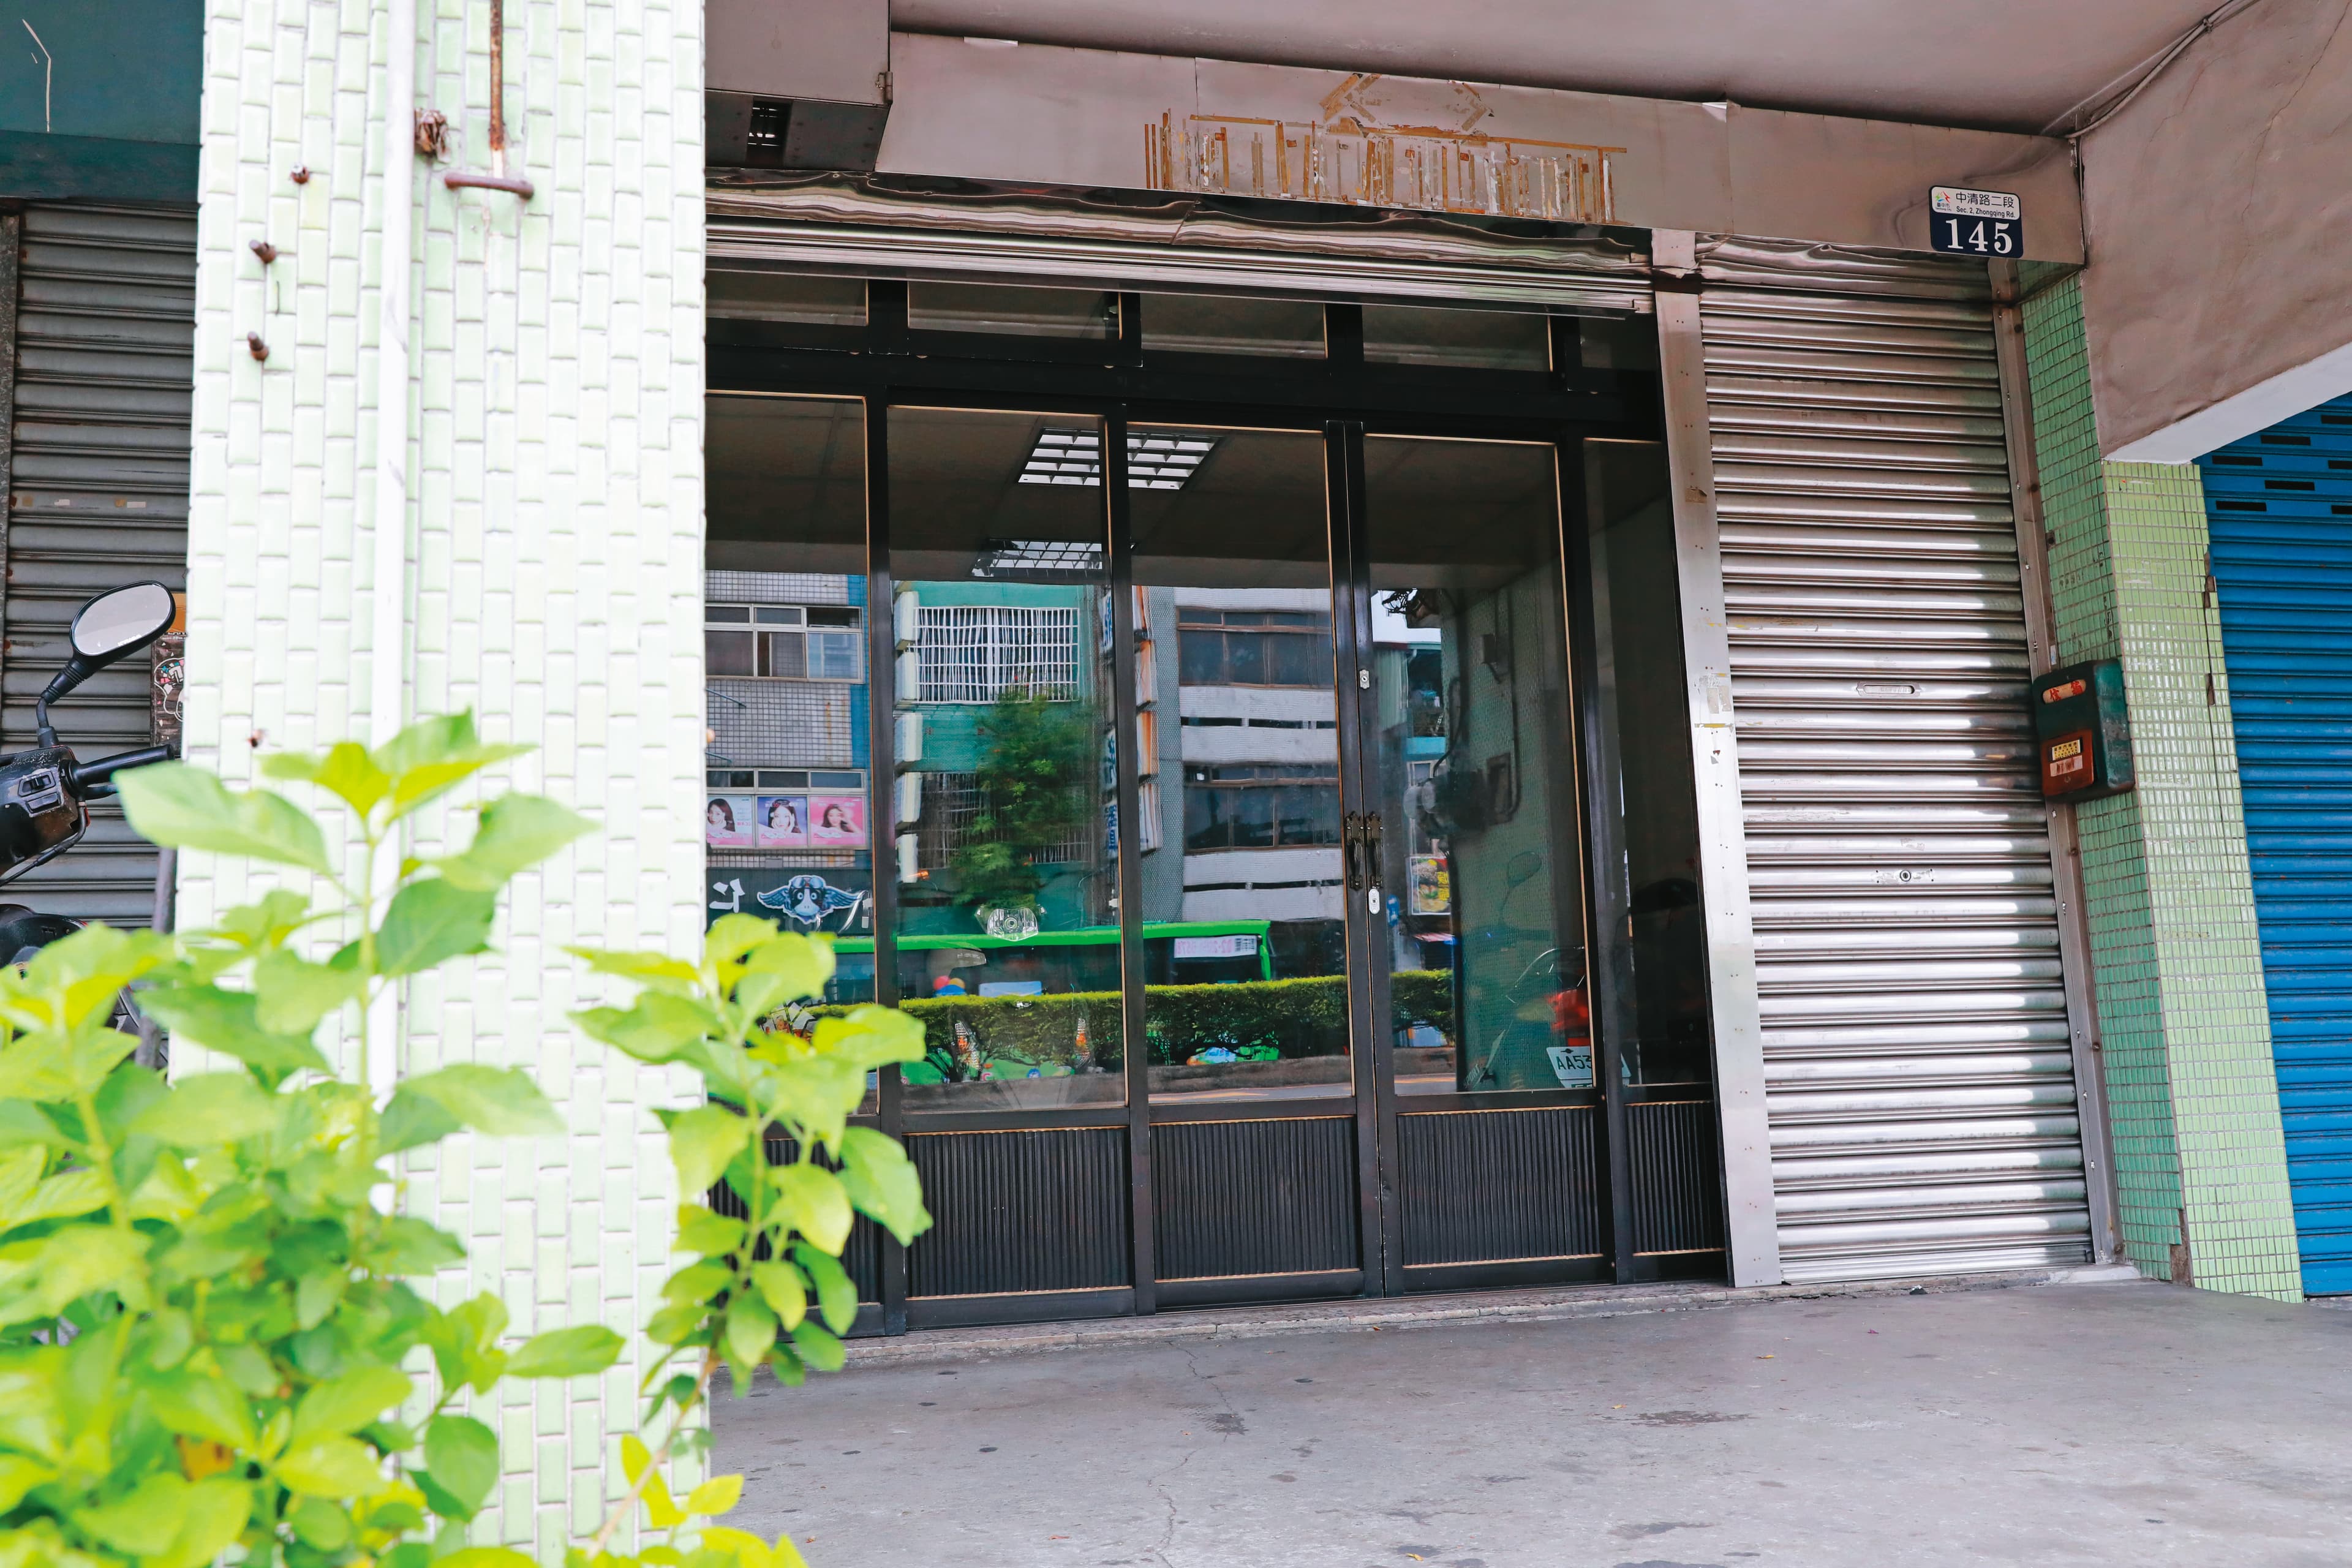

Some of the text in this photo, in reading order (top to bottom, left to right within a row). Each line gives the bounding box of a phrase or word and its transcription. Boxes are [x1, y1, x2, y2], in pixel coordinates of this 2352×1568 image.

[1956, 192, 2014, 208] 中清路二段
[1975, 208, 2005, 218] Zhongqing
[1945, 218, 2013, 254] 145
[1556, 1055, 1592, 1071] AA53
